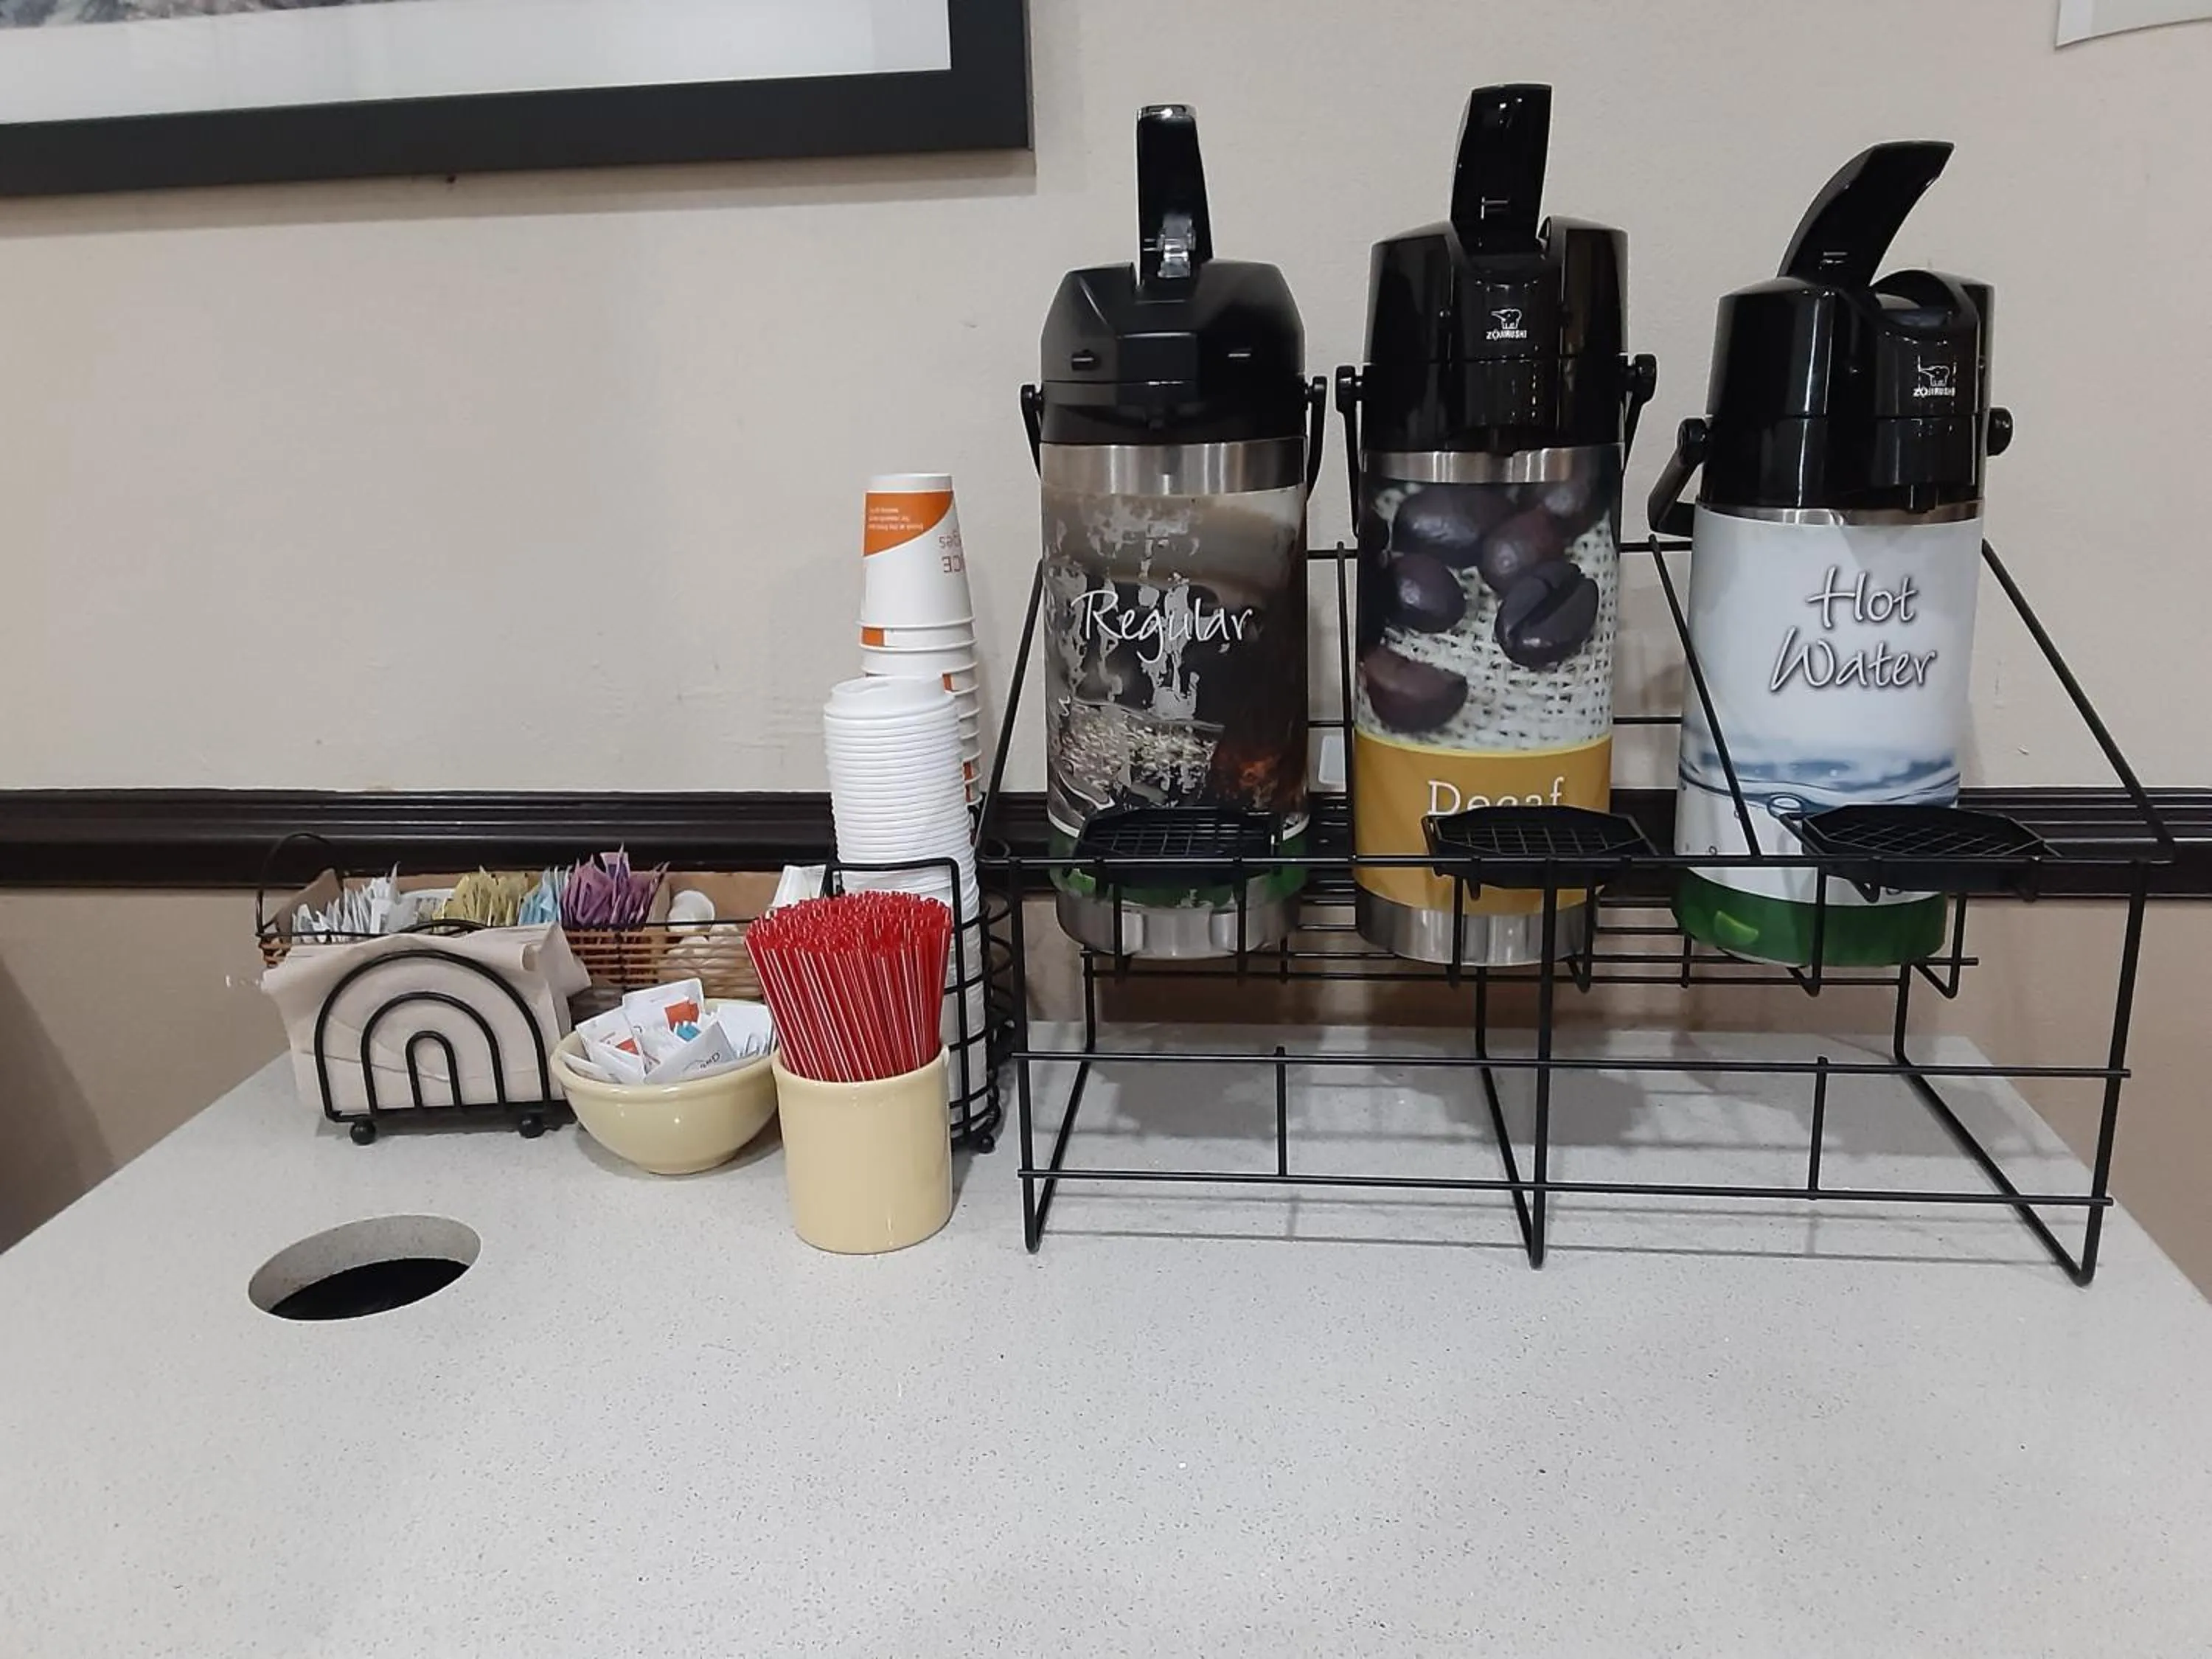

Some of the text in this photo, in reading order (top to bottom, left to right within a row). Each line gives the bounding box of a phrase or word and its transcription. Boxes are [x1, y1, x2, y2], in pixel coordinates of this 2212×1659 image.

[1071, 590, 1253, 663] Regular
[1806, 566, 1917, 628] Hot
[1770, 626, 1937, 692] Water
